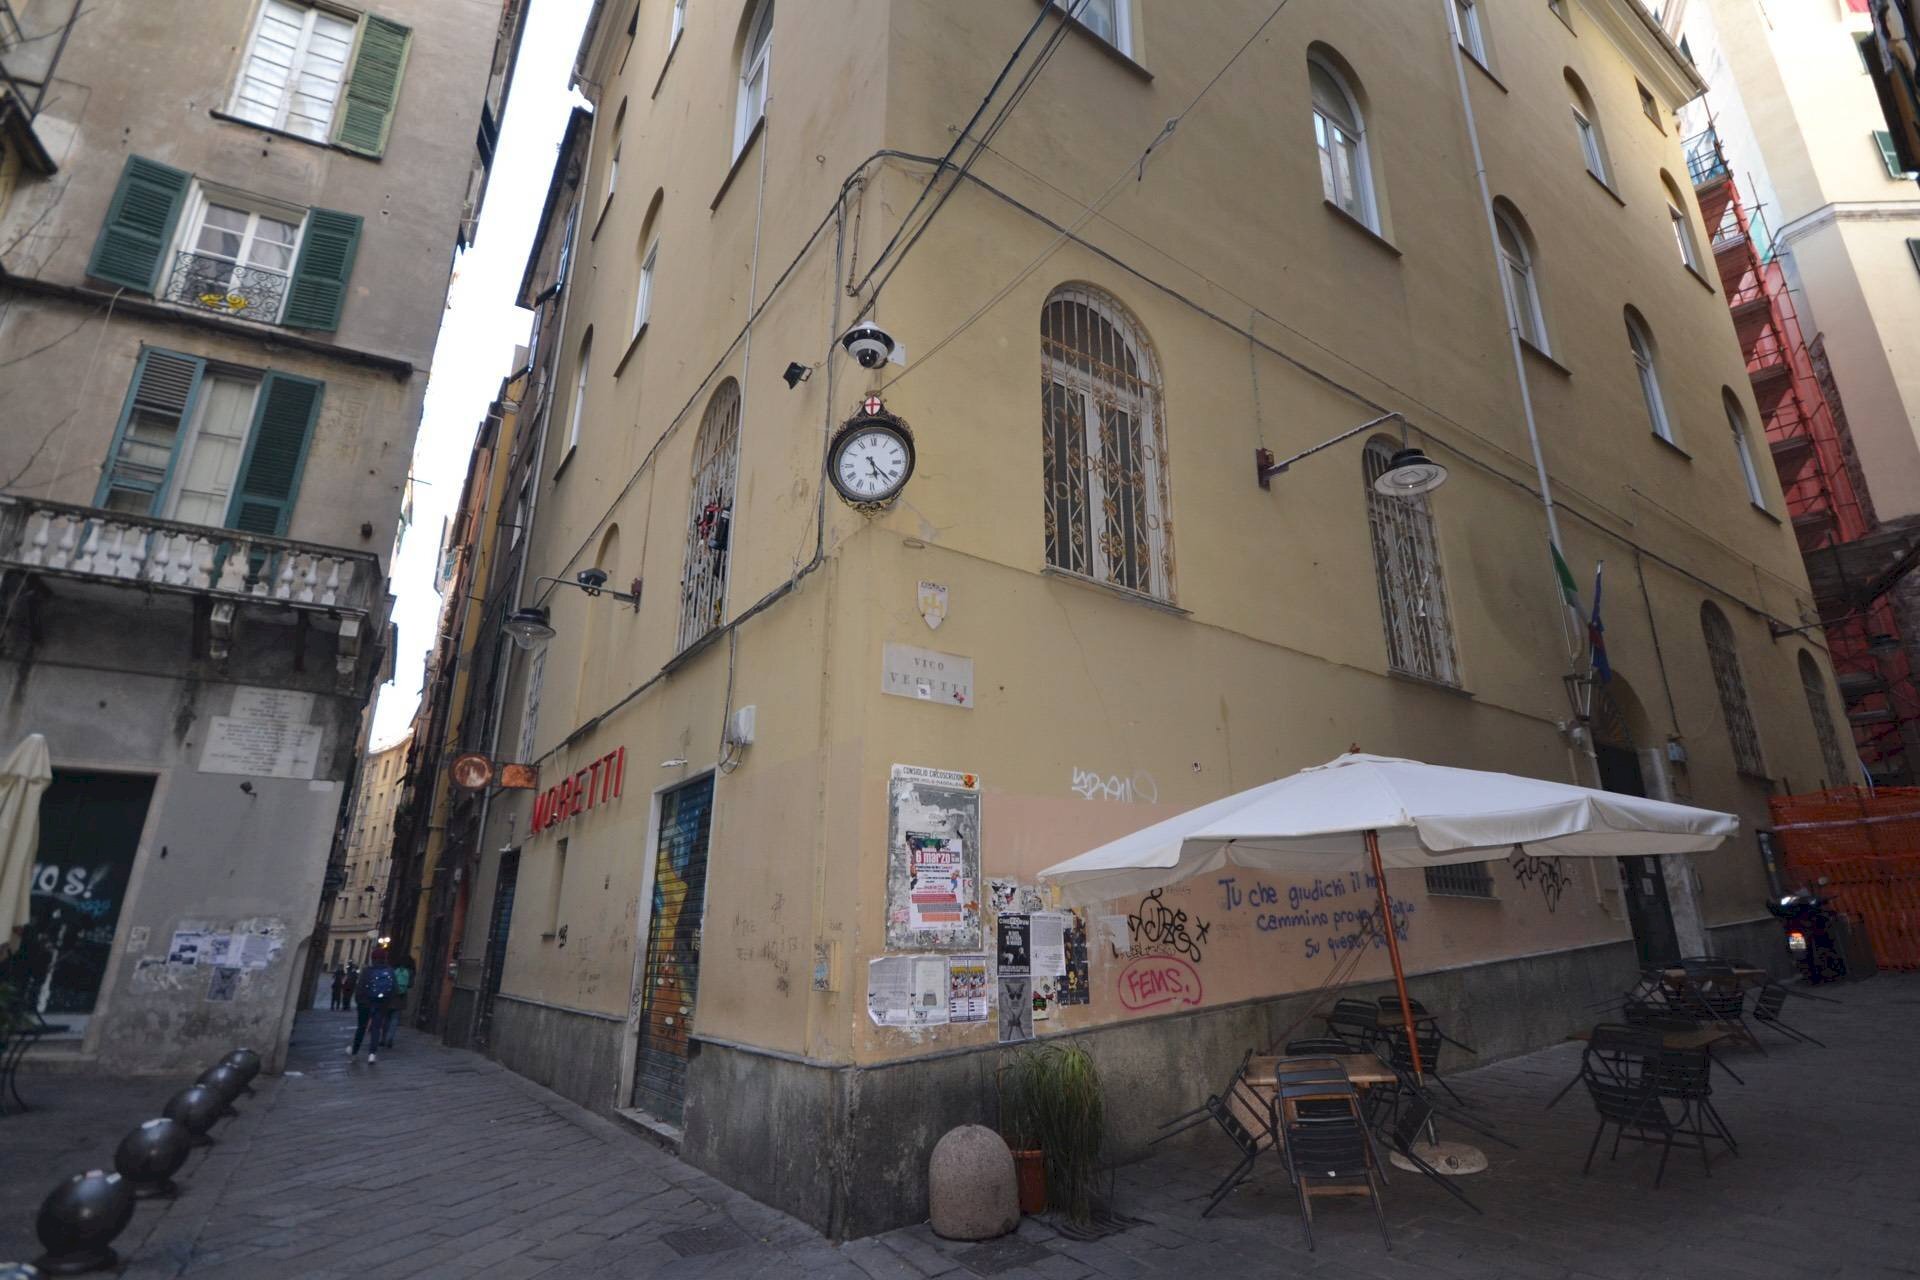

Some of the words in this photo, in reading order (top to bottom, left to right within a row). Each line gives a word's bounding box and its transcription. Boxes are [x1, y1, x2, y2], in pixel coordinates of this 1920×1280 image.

[914, 657, 944, 671] VICO
[531, 746, 625, 833] MORETTI
[924, 852, 951, 864] marzo
[1218, 877, 1242, 911] Tu
[1248, 882, 1278, 907] che
[1288, 878, 1346, 911] giudichi
[1350, 871, 1361, 893] il
[1256, 909, 1329, 932] cammino
[1304, 938, 1320, 959] Su
